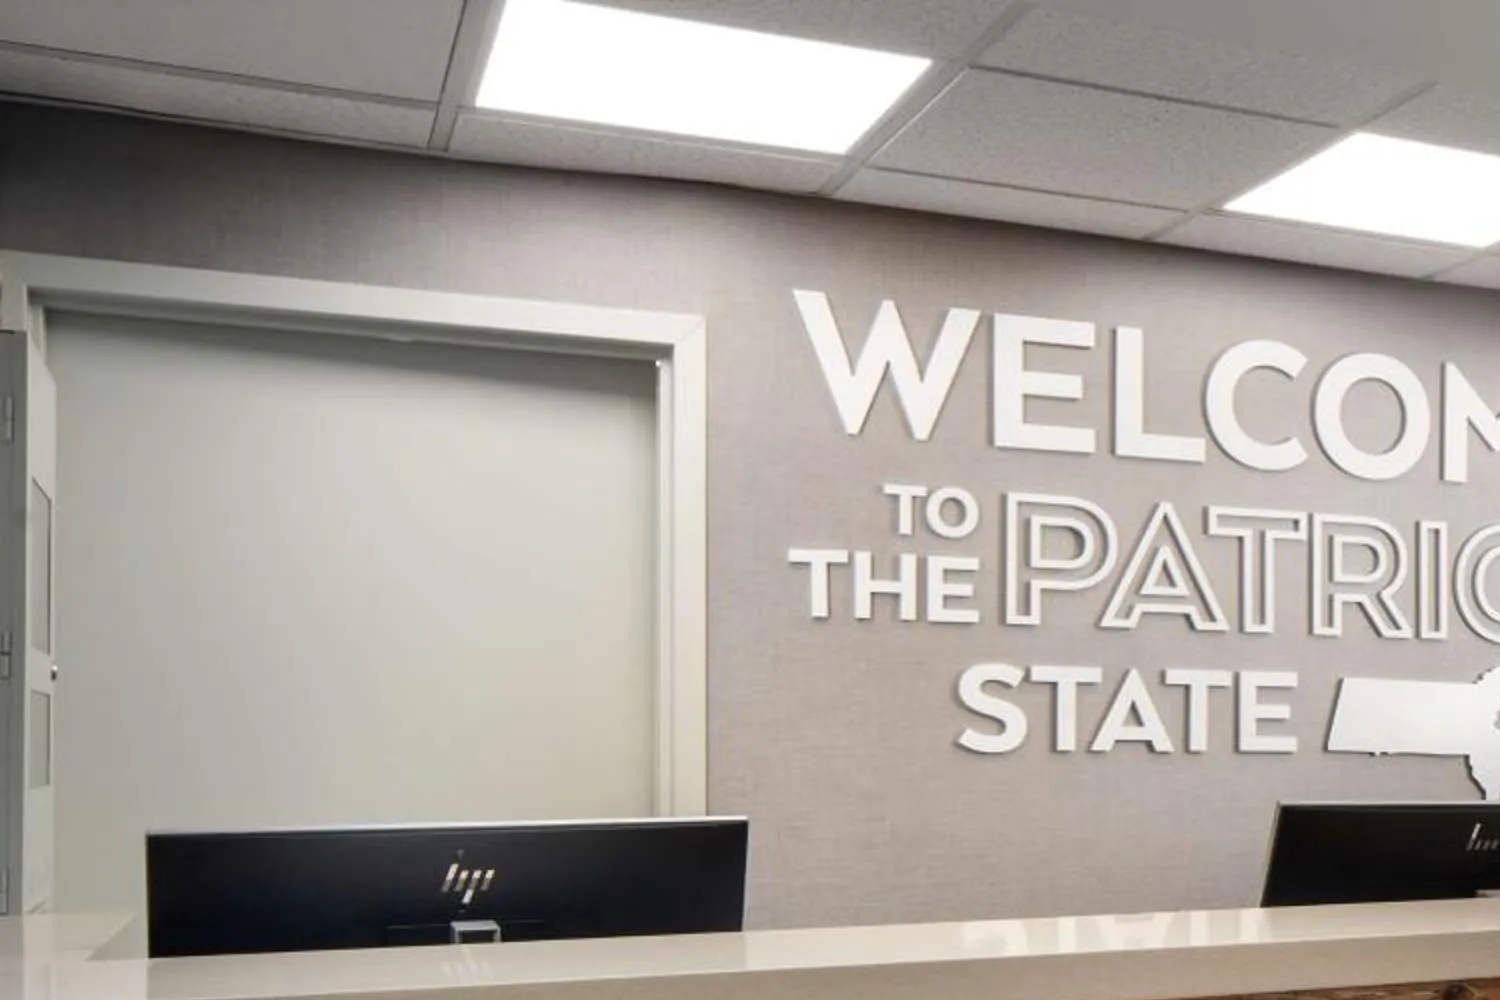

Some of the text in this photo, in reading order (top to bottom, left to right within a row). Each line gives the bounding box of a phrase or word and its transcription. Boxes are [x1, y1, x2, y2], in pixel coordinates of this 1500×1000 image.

[883, 482, 980, 539] TO
[787, 548, 980, 624] THE
[955, 661, 1299, 754] STATE
